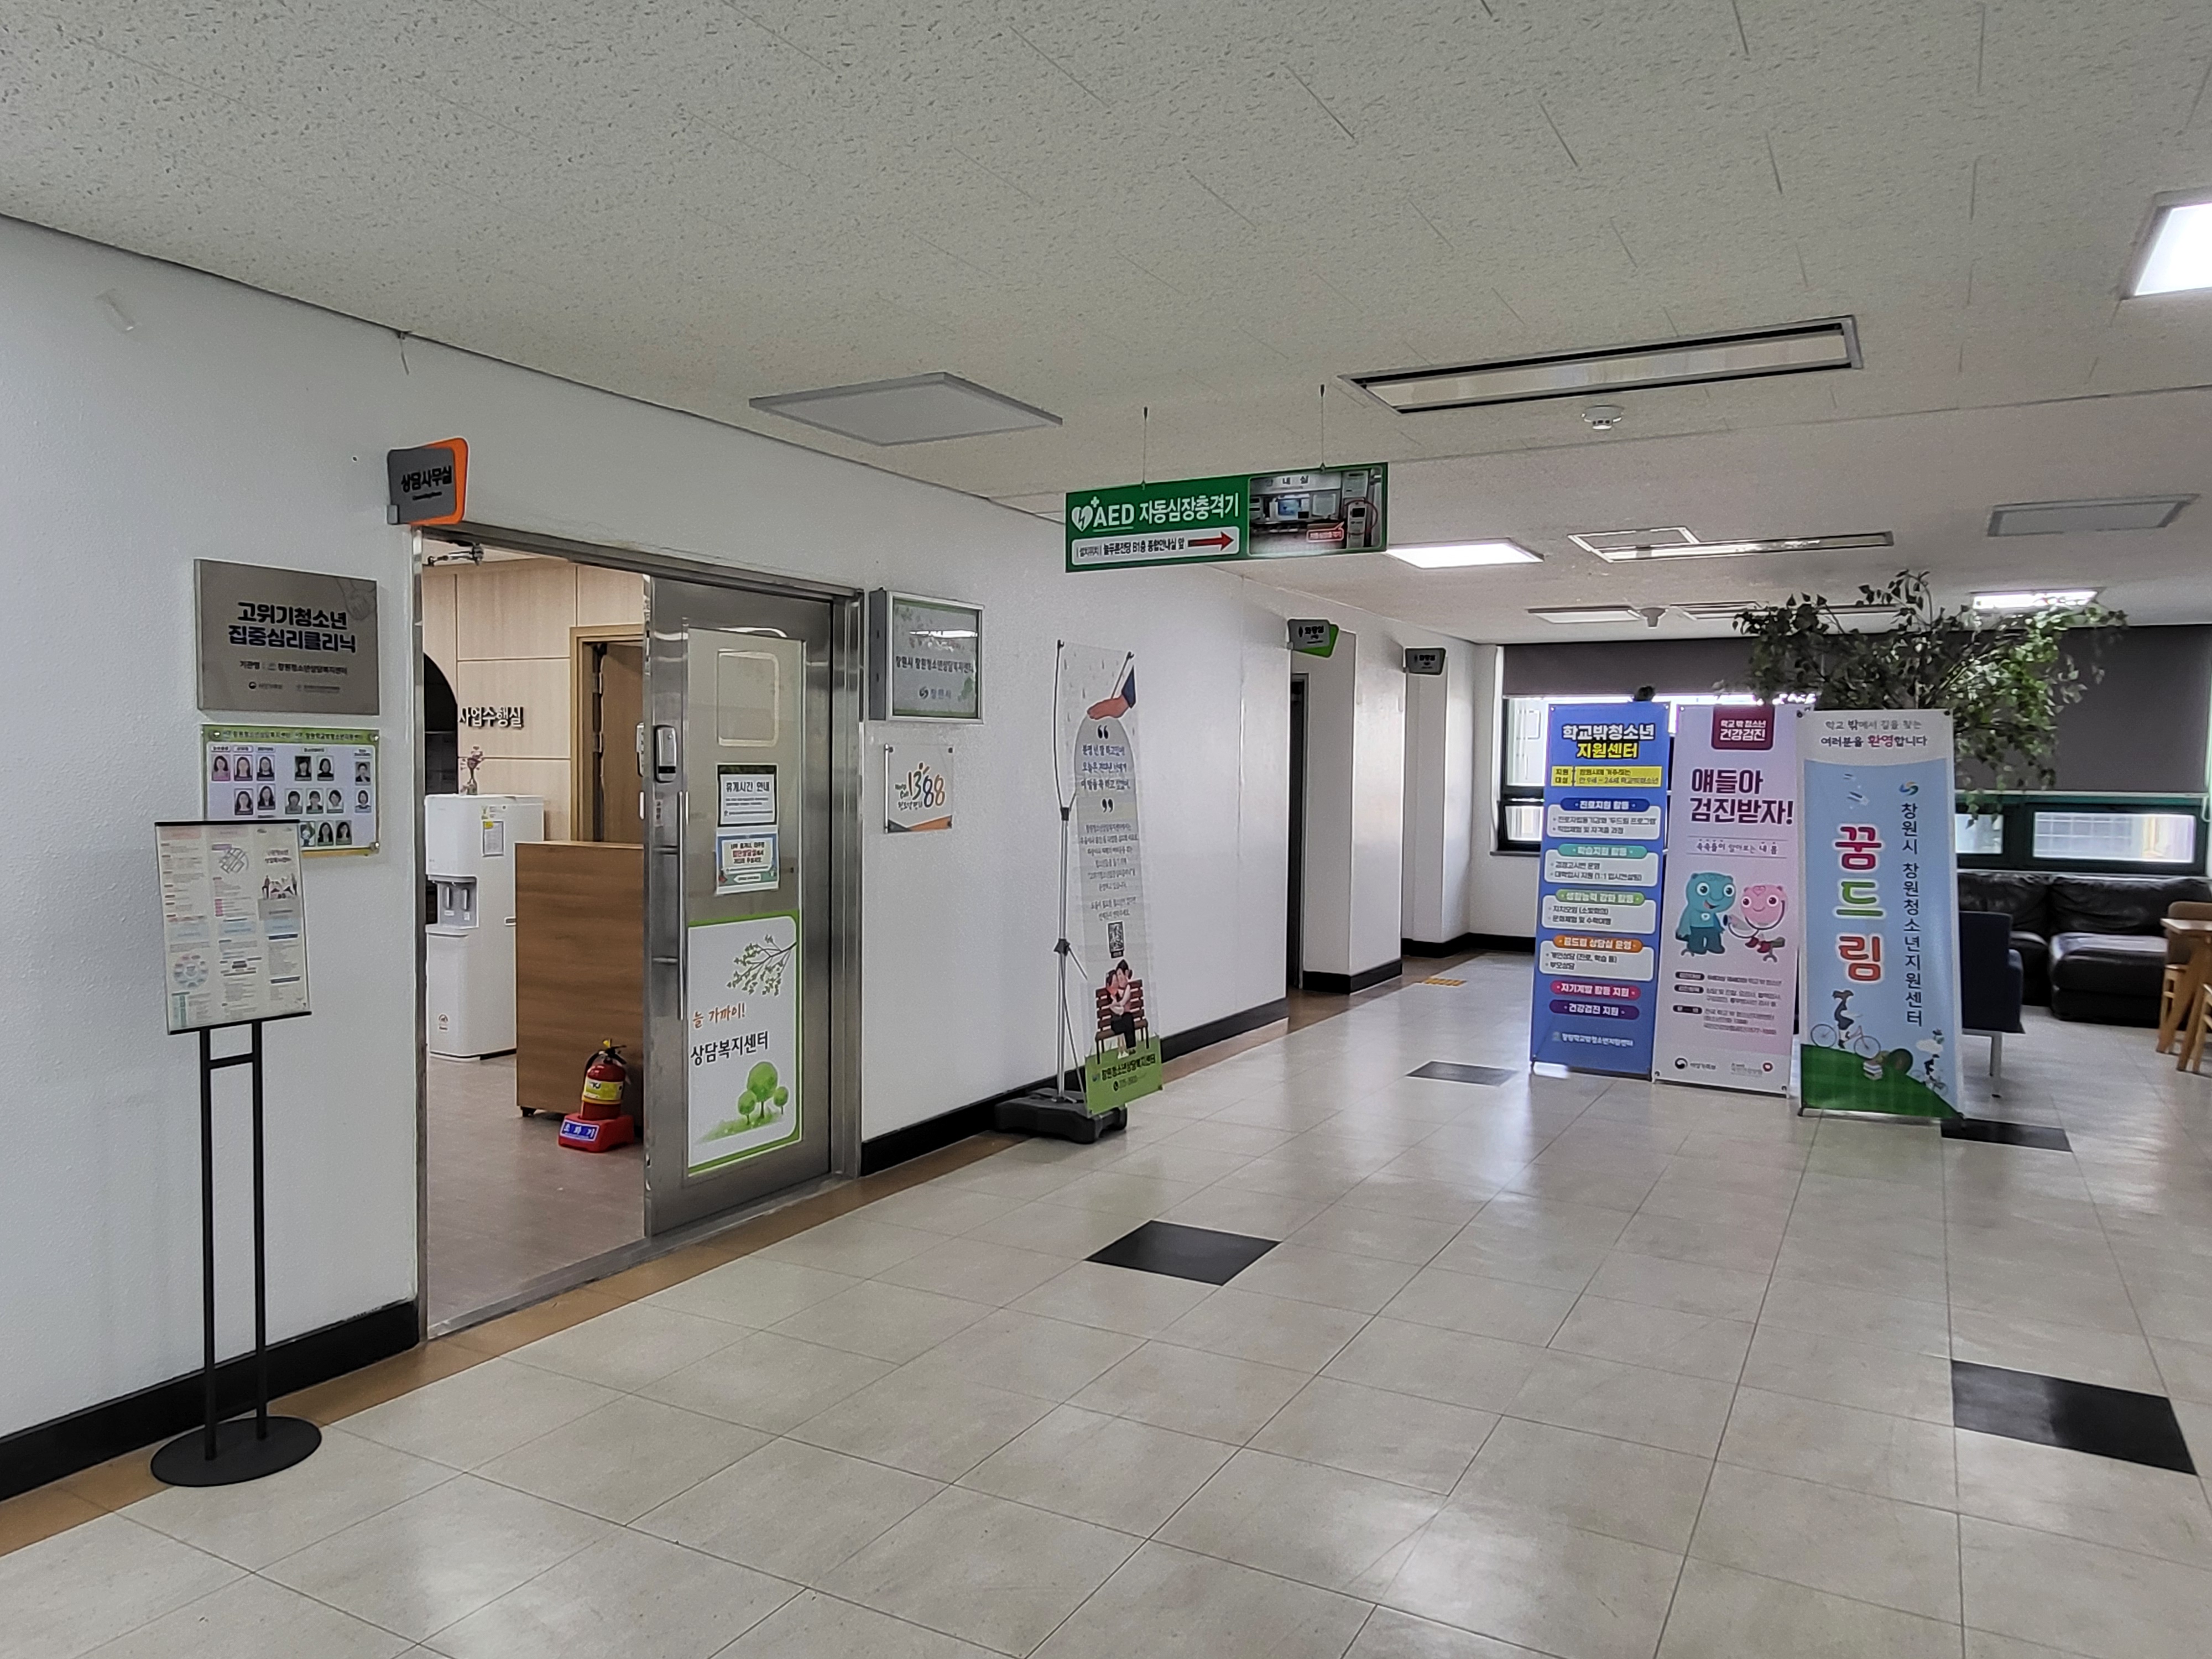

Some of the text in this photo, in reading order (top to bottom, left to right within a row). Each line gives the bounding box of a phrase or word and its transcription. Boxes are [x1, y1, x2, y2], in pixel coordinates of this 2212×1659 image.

[401, 466, 452, 493] 상담사무실
[1093, 492, 1239, 528] AED 자동심장충격기
[237, 602, 347, 630] 고위기청소년
[228, 625, 356, 653] 집중심리클리닉
[457, 707, 524, 729] 사업수행실
[1825, 721, 1844, 730] 학교
[1562, 724, 1655, 740] 학교밖청소년
[1720, 729, 1765, 741] 건강검진
[1820, 735, 1927, 747] 여러분을 환영합니다
[1577, 743, 1637, 758] 지원센터
[757, 781, 769, 792] 안내
[908, 771, 946, 808] 1388
[1692, 769, 1764, 794] 얘들아
[1690, 797, 1793, 825] 검진받자!
[1835, 826, 1884, 982] 꿈드림
[1901, 803, 1922, 1027] 창원시 창원청소년지원센터
[693, 1002, 745, 1029] 늘 가까이!
[691, 1031, 768, 1066] 상담복지센터
